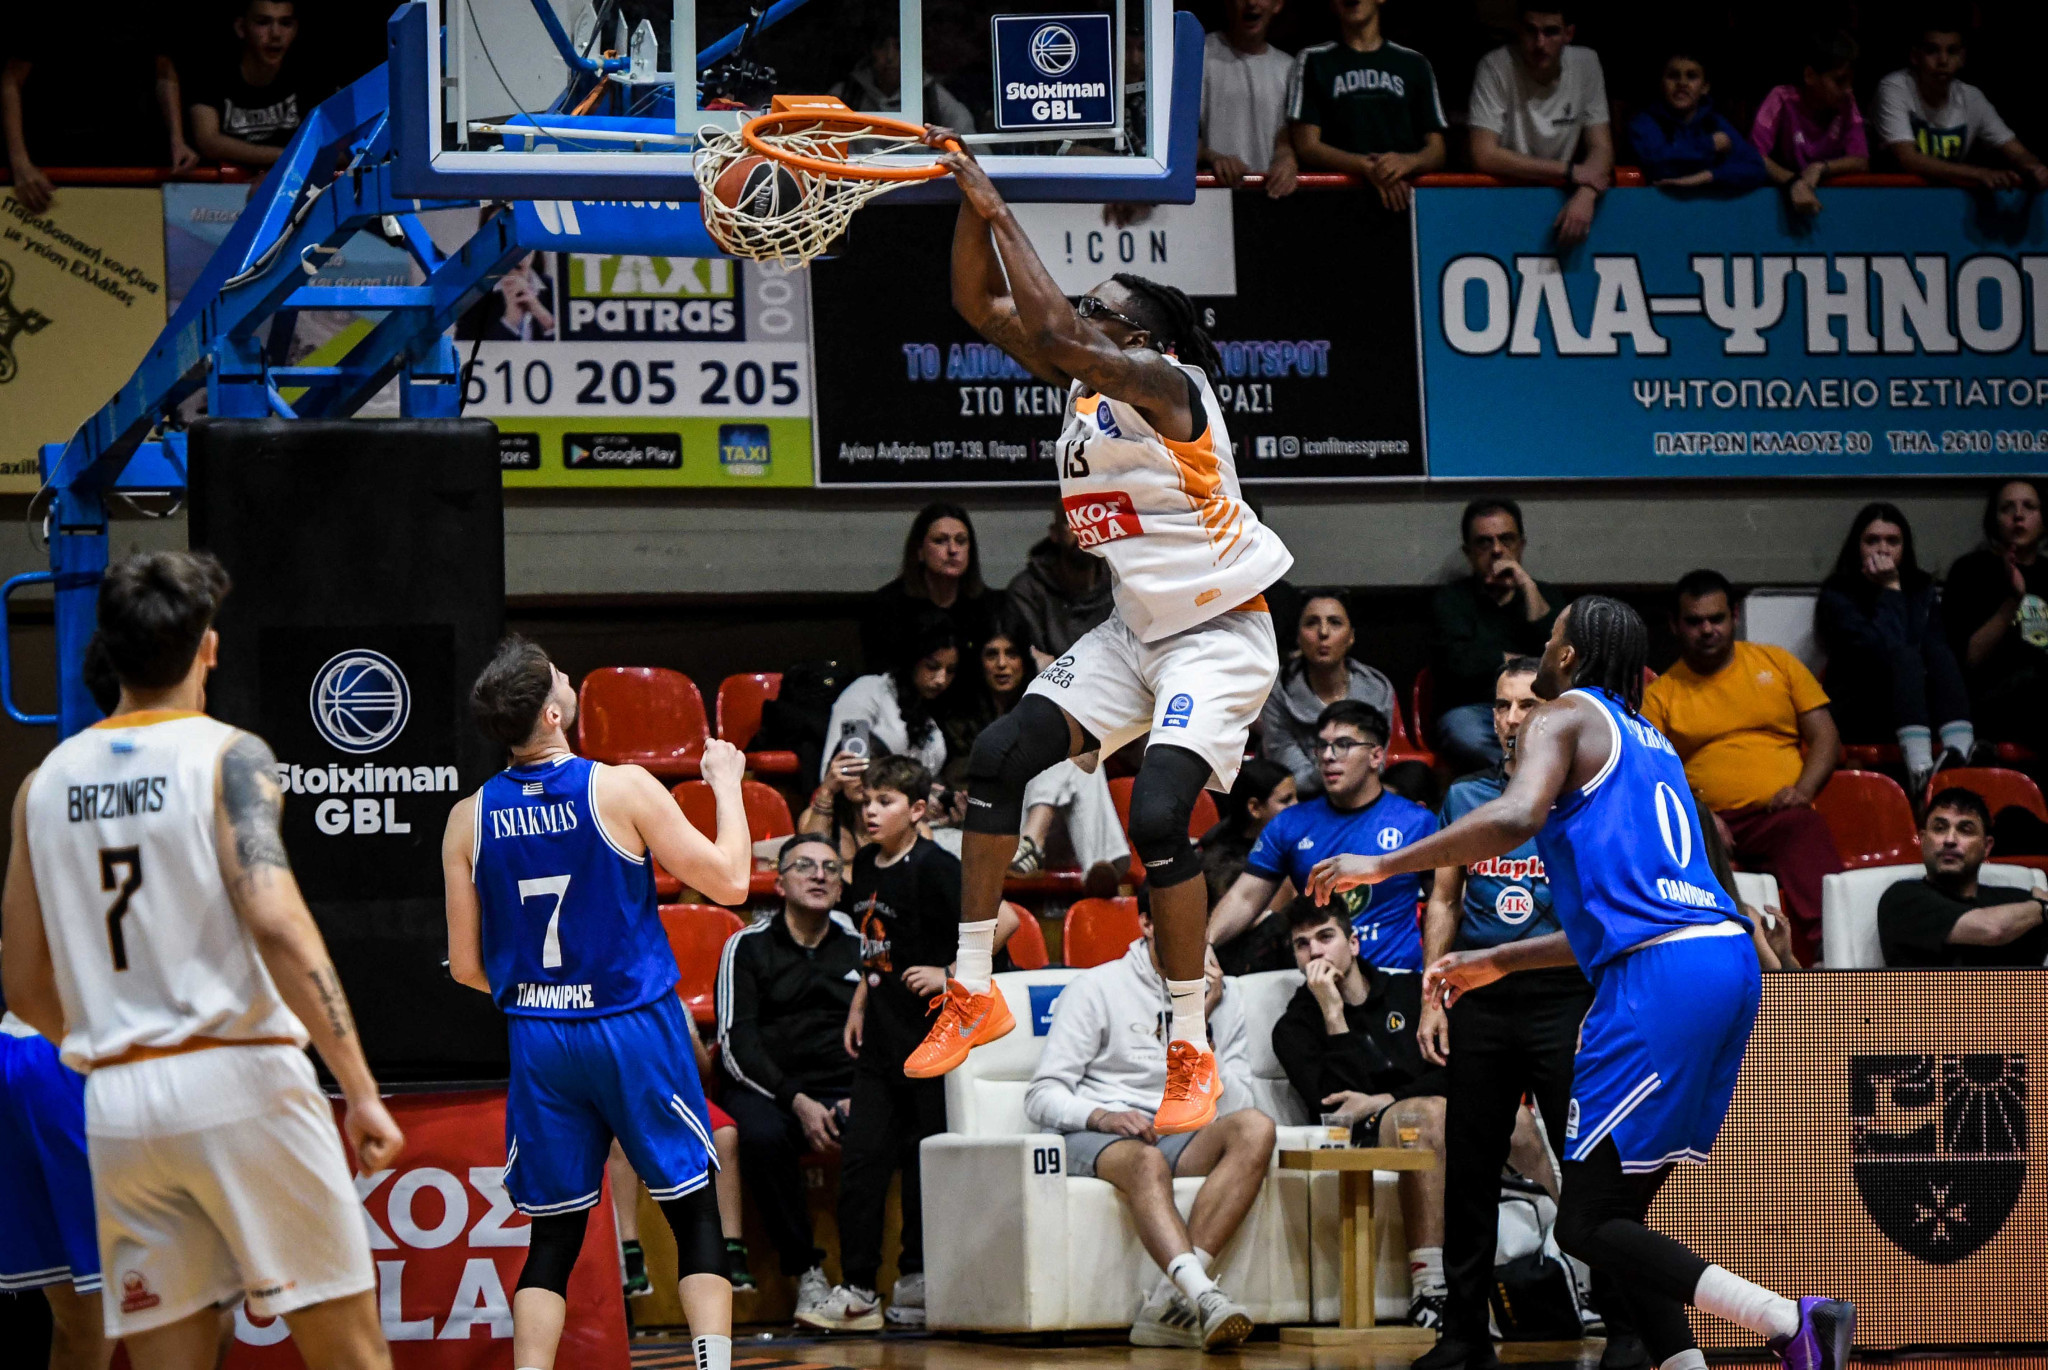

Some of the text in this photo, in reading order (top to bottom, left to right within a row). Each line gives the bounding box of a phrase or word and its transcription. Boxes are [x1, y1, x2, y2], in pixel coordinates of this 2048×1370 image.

[1006, 81, 1106, 100] Stoiximan
[1333, 68, 1405, 98] ADIDAS
[1032, 100, 1081, 120] GBL
[569, 254, 729, 293] TAXI
[1441, 255, 2048, 354] ΟΛΑ-ΨΗΝΟ
[575, 360, 678, 405] 205
[699, 360, 800, 405] 205
[1632, 378, 1880, 409] ΨΗΤΟΠΩΛΕΙΟ
[959, 387, 1004, 416] ΣΤΟ
[593, 446, 677, 465] Google Play
[723, 446, 768, 461] TAXI
[1063, 439, 1091, 479] 13
[1654, 431, 1748, 456] ΠΑΤΡΩΝ
[1845, 430, 1873, 454] 30
[1941, 430, 1994, 454] 2610
[276, 762, 459, 794] Stoiximan
[67, 776, 167, 823] BAZINAS
[315, 798, 411, 836] GBL
[489, 800, 578, 839] TSIAKMAS
[1654, 781, 1692, 869] 0
[98, 844, 143, 972] 7
[1500, 898, 1528, 912] AK
[518, 874, 571, 969] 7
[1034, 1147, 1061, 1175] 09
